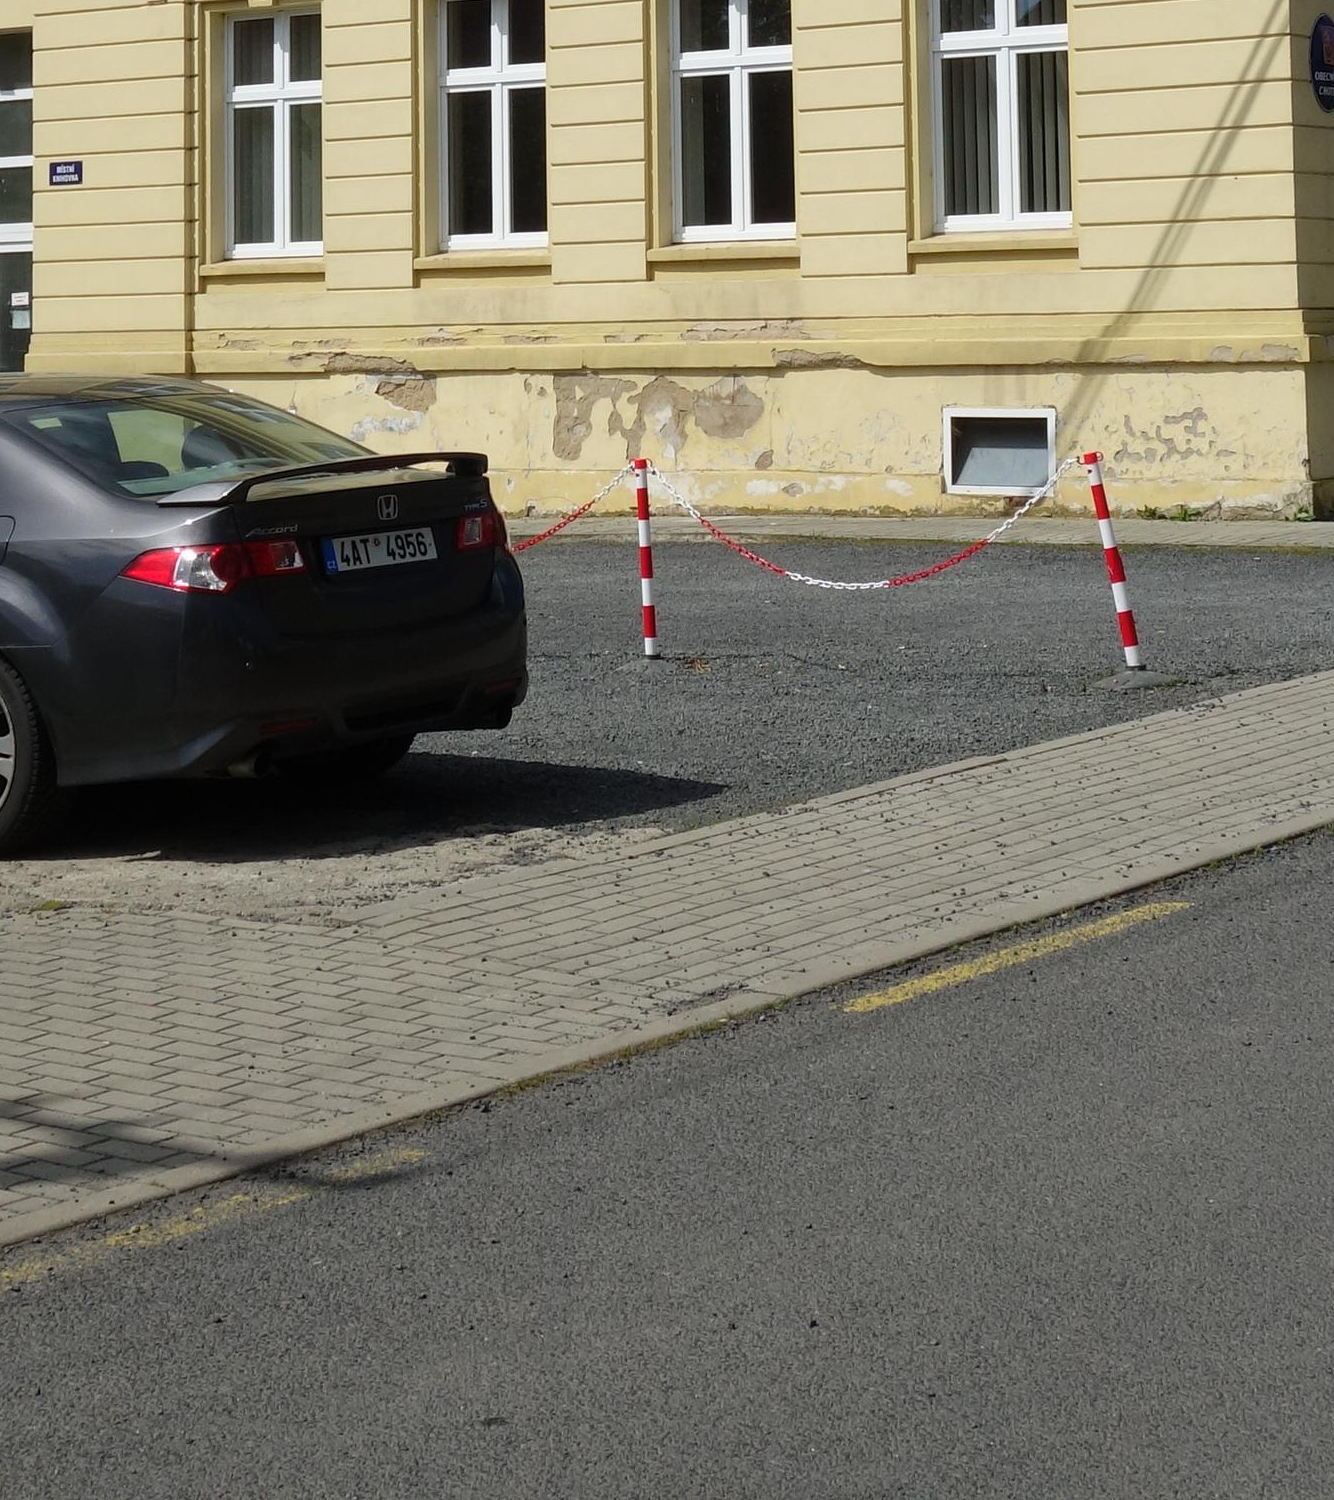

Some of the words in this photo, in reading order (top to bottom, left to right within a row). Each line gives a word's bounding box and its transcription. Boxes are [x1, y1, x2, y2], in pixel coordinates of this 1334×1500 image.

[245, 523, 298, 538] Accord
[340, 539, 372, 567] 4AT
[386, 532, 428, 561] 4956
